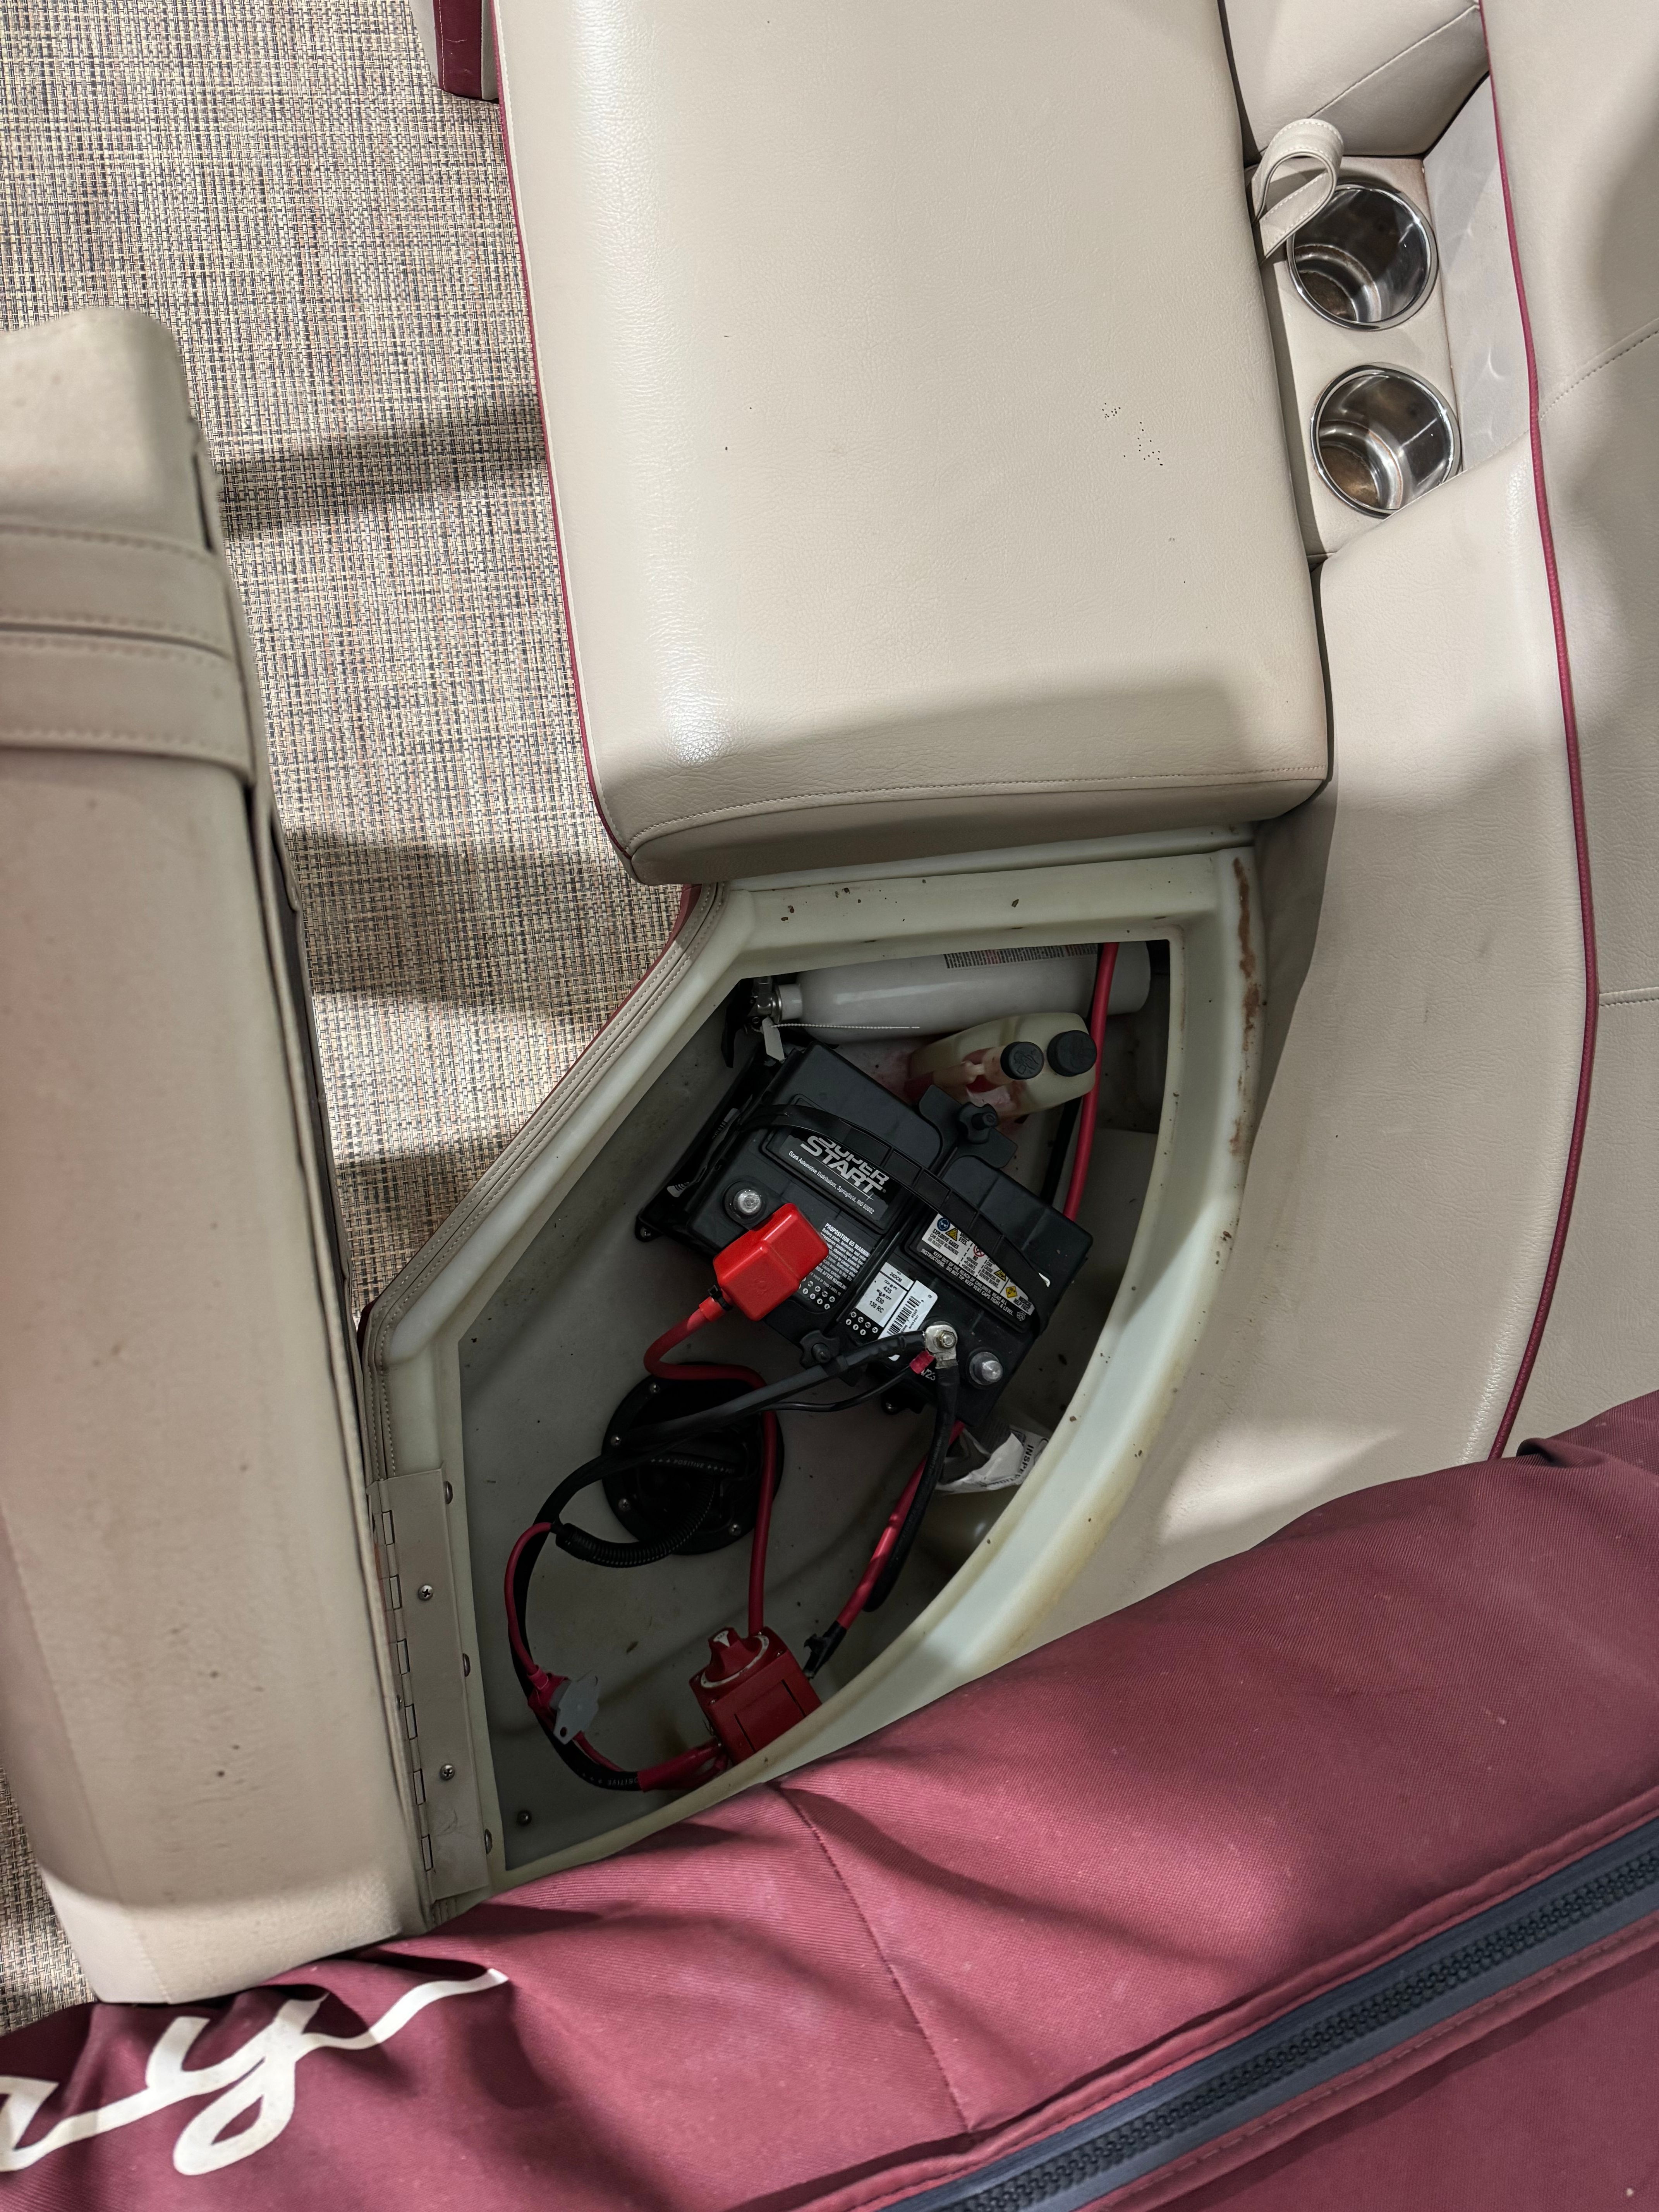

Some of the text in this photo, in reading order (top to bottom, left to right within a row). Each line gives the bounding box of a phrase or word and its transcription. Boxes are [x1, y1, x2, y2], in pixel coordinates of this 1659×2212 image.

[800, 1135, 883, 1194] START
[818, 1137, 890, 1185] SUPER
[788, 1151, 799, 1161] Ozark
[798, 1158, 817, 1174] Automotive
[816, 1171, 836, 1188] Distributors,
[837, 1185, 856, 1202] Springfield,
[824, 1223, 850, 1243] PROPOSITION
[854, 1243, 871, 1258] WARNIN
[932, 1228, 949, 1242] EXPLOSIVE
[822, 1271, 833, 1280] AFTER
[959, 1269, 970, 1279] REACH
[991, 1292, 1001, 1300] READ
[829, 1285, 838, 1293] LABEL
[973, 1285, 982, 1293] VENT
[981, 1290, 991, 1299] CAPS
[990, 1297, 1001, 1305] TIGHT
[876, 1296, 884, 1304] 530
[673, 1459, 704, 1468] POSITIVE
